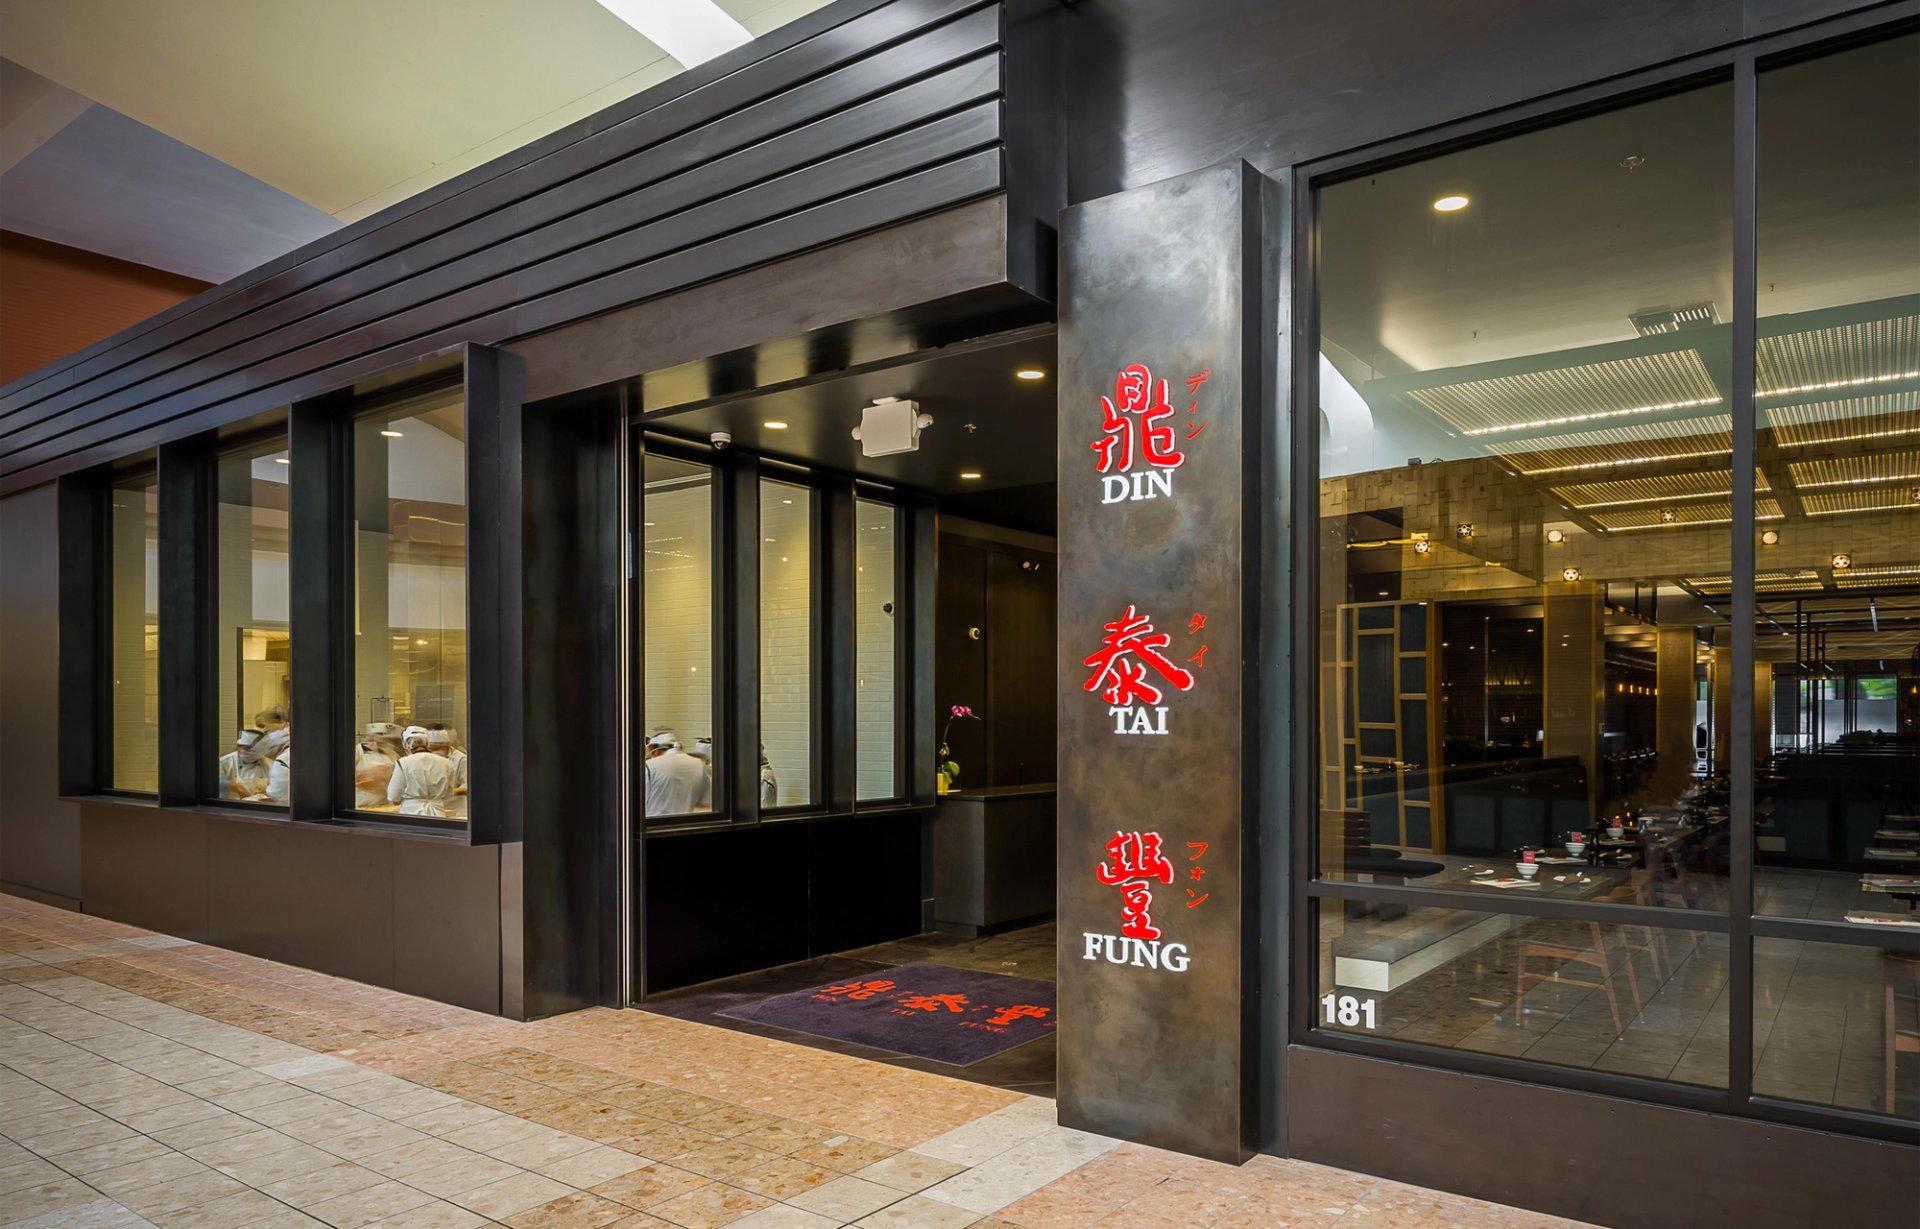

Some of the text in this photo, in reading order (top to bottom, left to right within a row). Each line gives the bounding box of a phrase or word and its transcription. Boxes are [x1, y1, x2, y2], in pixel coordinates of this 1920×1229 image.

[1090, 363, 1186, 472] 鼎
[1185, 369, 1212, 441] ディン
[1101, 467, 1175, 505] DIN
[1083, 604, 1195, 706] 泰
[1187, 612, 1209, 668] タイ
[1108, 706, 1170, 736] TAI
[1185, 841, 1209, 909] フォン
[1082, 932, 1191, 973] FUNG
[1321, 993, 1376, 1030] 181
